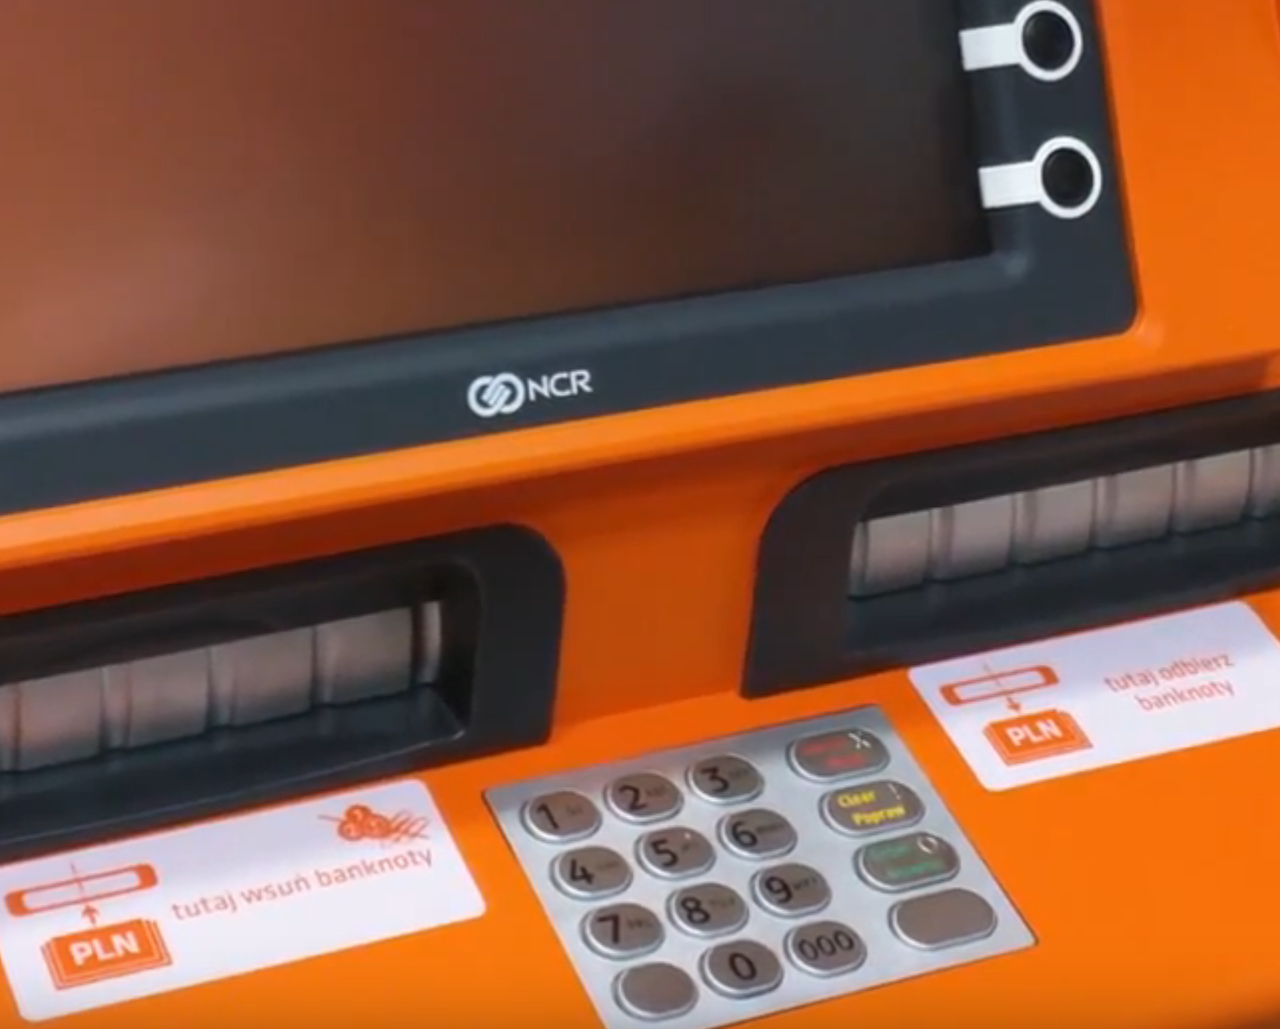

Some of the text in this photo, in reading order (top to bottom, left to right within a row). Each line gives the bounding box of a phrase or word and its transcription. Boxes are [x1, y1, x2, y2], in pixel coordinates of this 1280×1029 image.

[527, 370, 593, 401] NCR
[1103, 653, 1235, 693] tutaj odbierz
[1134, 678, 1236, 712] banknoty
[1005, 719, 1063, 746] PLN
[700, 767, 730, 793] 3
[619, 784, 648, 812] 2
[536, 803, 559, 831] 1
[731, 821, 758, 848] 6
[651, 839, 678, 867] 5
[172, 848, 433, 920] tutaj wsuń banknoty
[570, 859, 594, 884] 4
[764, 876, 793, 903] 9
[680, 896, 711, 925] 8
[597, 914, 620, 944] 7
[69, 930, 142, 967] PLN
[799, 930, 854, 961] 000
[728, 952, 757, 981] 0
